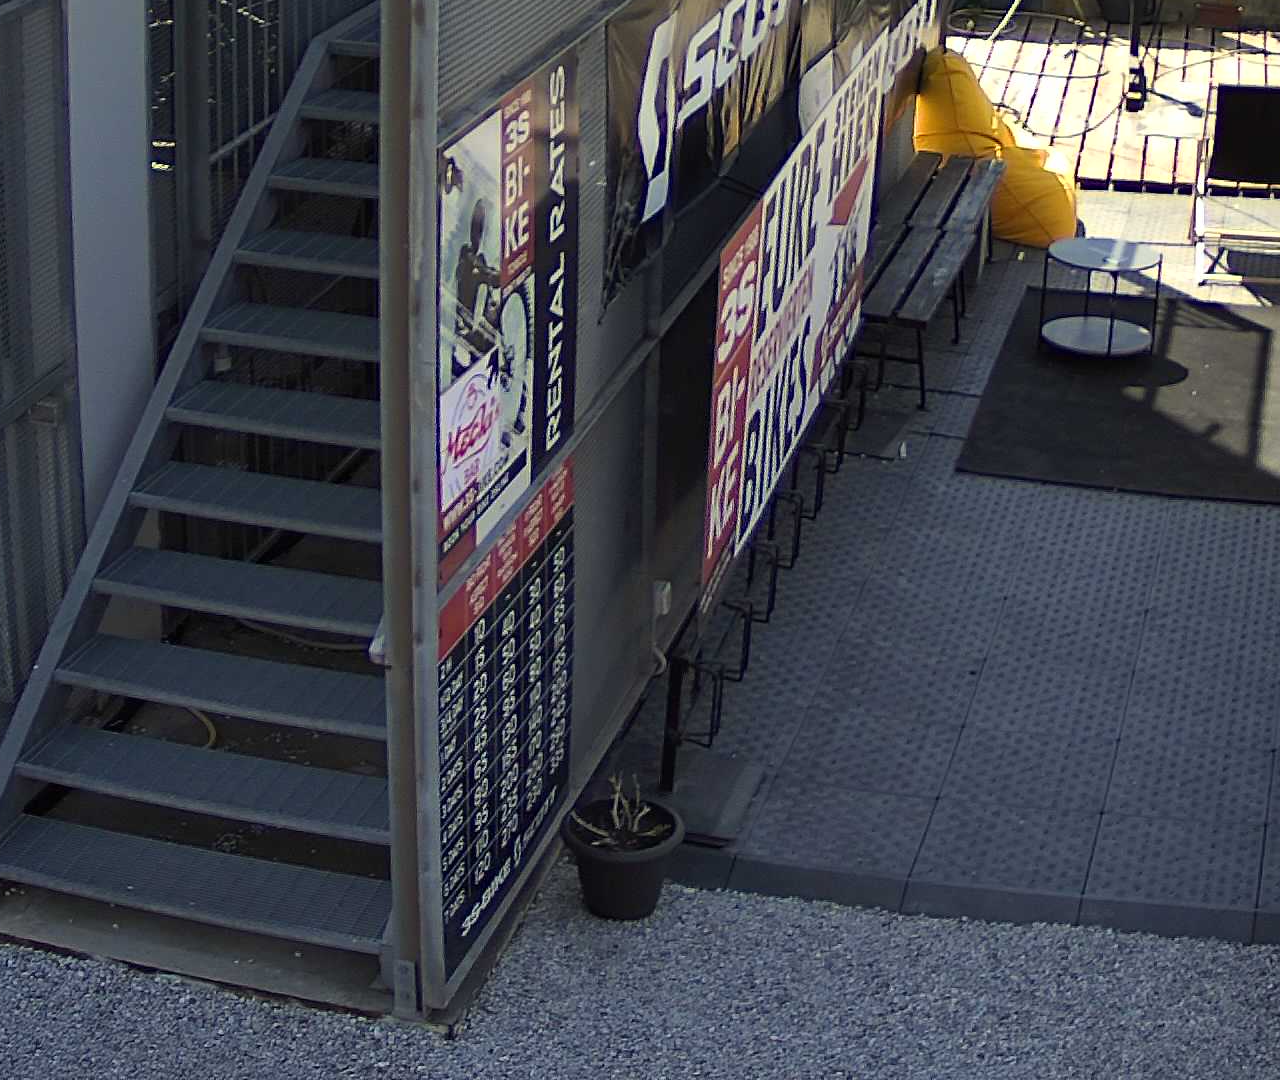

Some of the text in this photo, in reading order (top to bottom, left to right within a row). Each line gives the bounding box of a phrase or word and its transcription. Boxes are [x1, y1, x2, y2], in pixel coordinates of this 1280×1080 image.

[506, 110, 530, 153] 3S
[549, 66, 566, 244] RATES
[506, 202, 530, 258] KE
[755, 118, 828, 344] EURE
[545, 252, 565, 451] RENTAL
[718, 261, 757, 363] 3S
[708, 441, 739, 559] KE
[737, 316, 811, 537] BIKES
